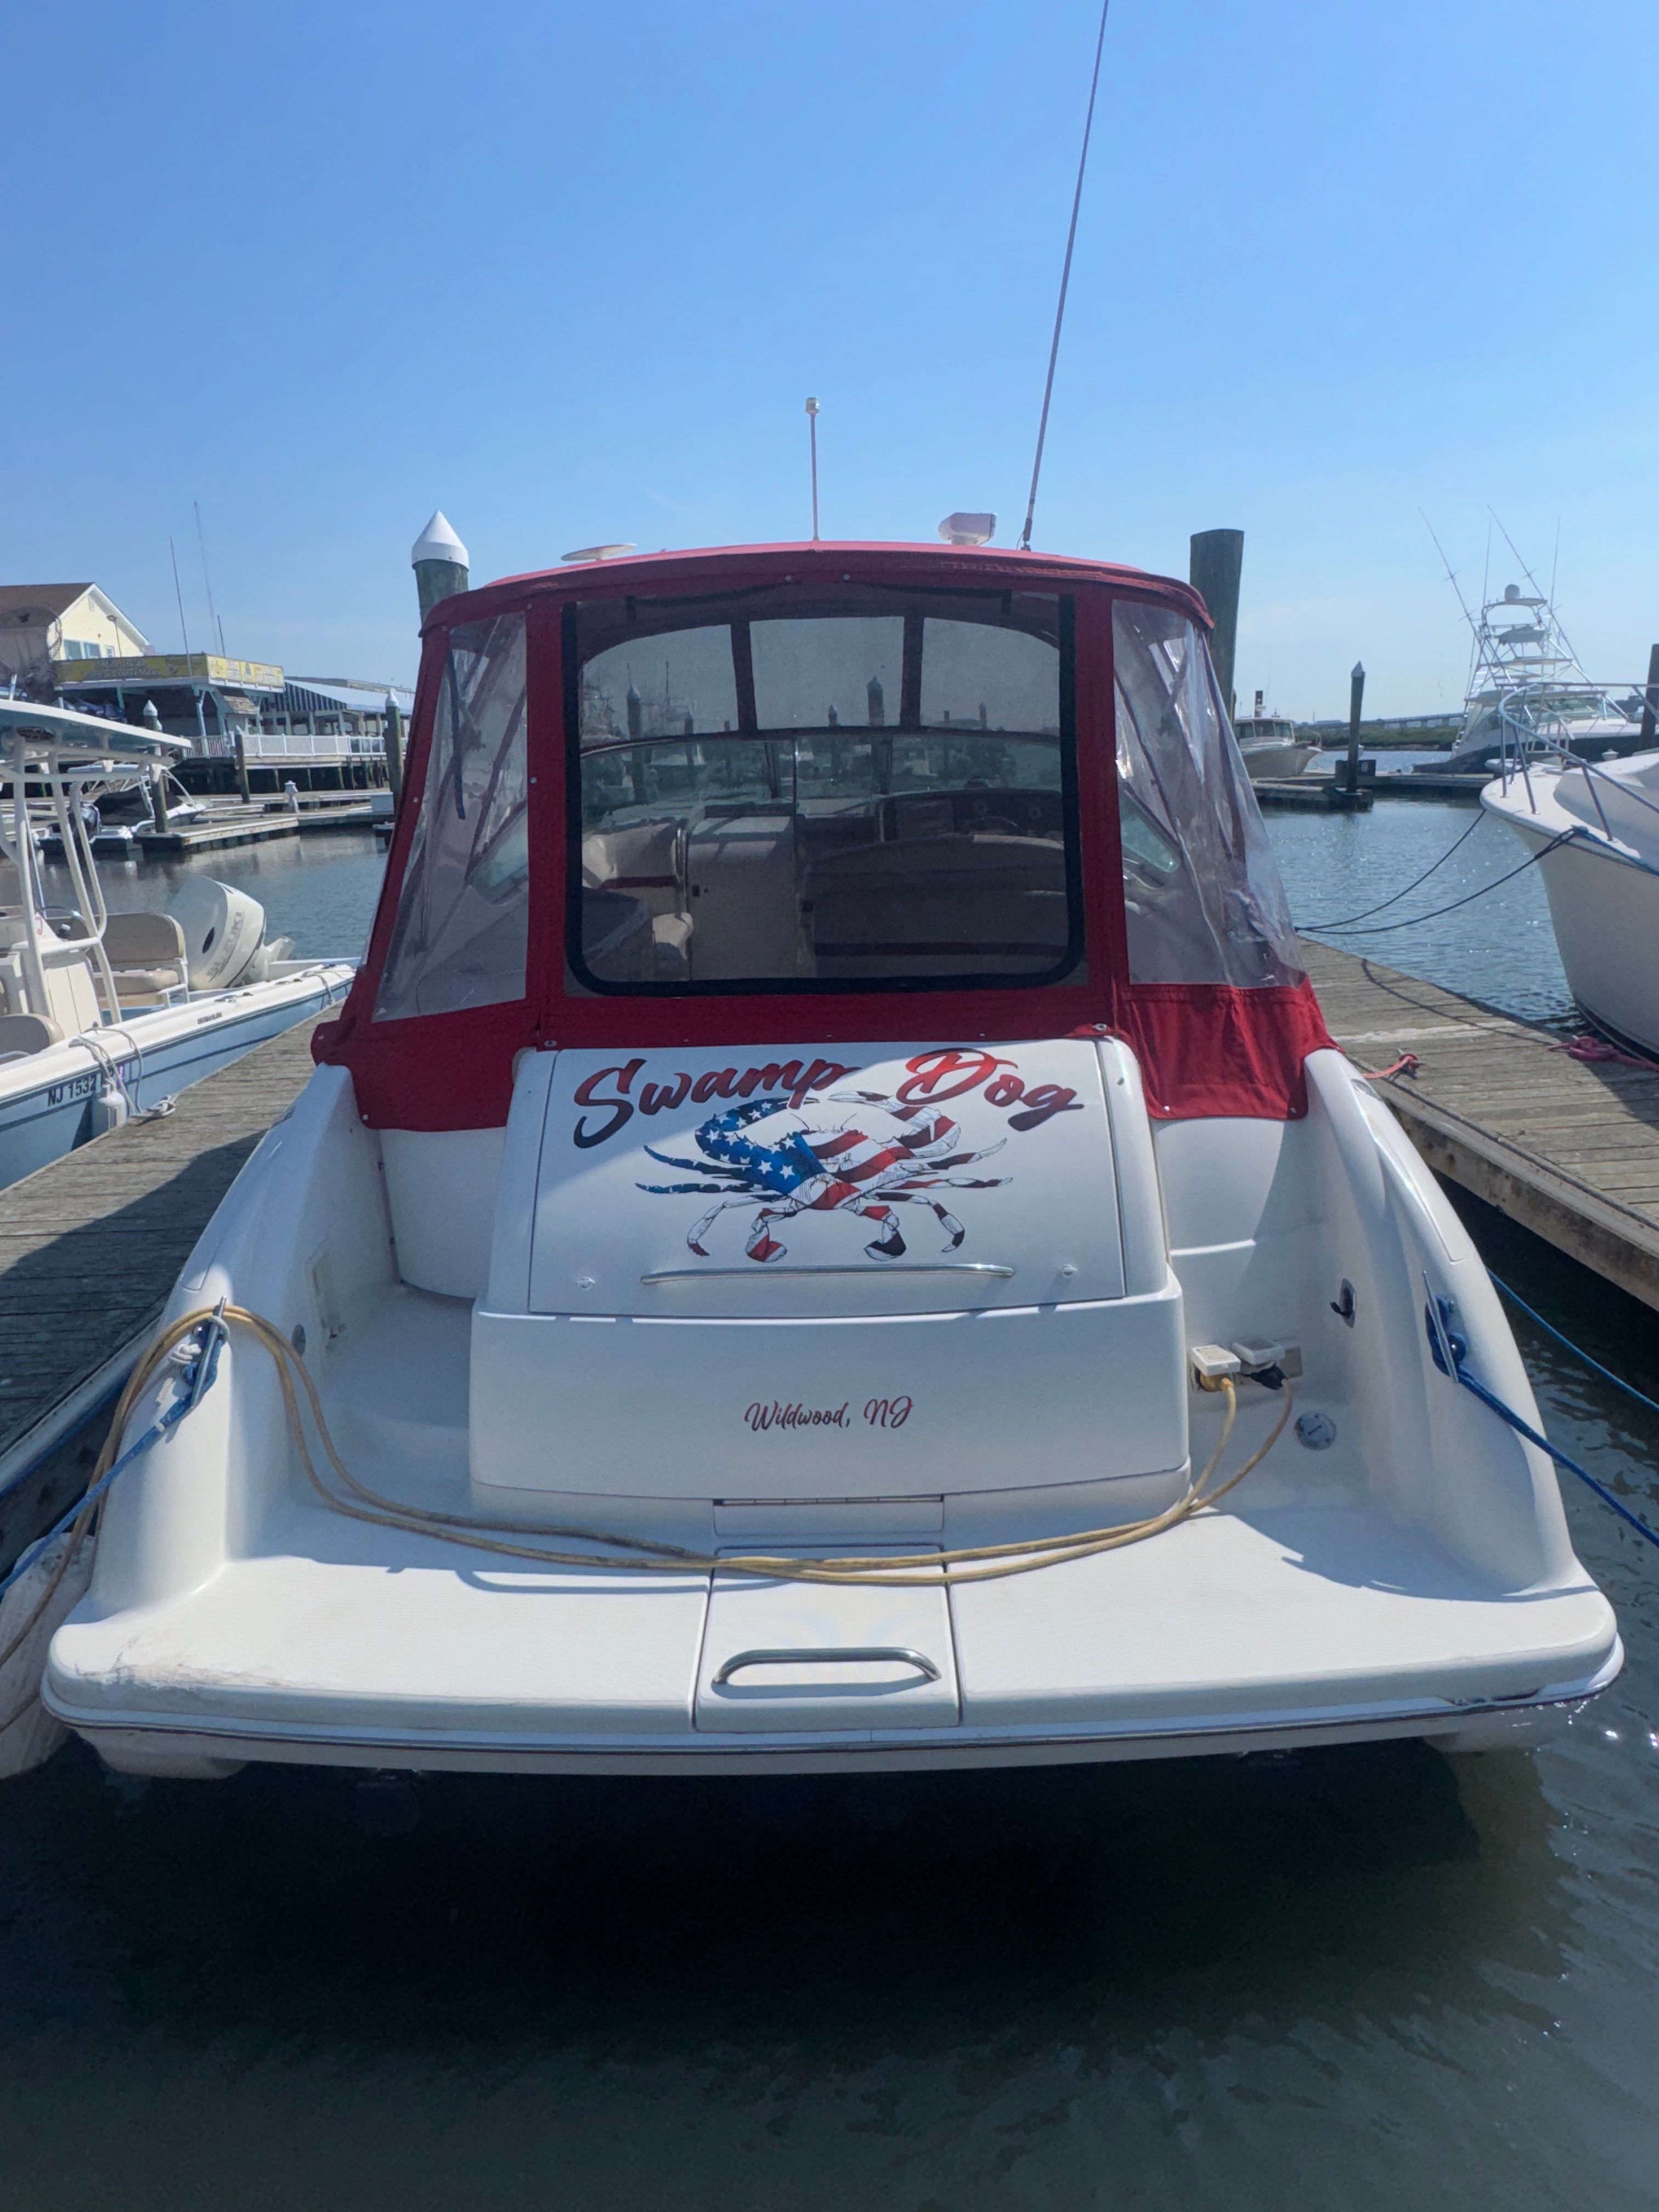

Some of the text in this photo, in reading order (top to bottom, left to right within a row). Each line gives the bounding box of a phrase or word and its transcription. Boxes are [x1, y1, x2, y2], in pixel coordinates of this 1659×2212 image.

[47, 1085, 64, 1107] NJ
[67, 1074, 97, 1099] 1532
[573, 1047, 1085, 1149] Swamp Dog
[744, 1395, 915, 1431] Wildwood, NJ
